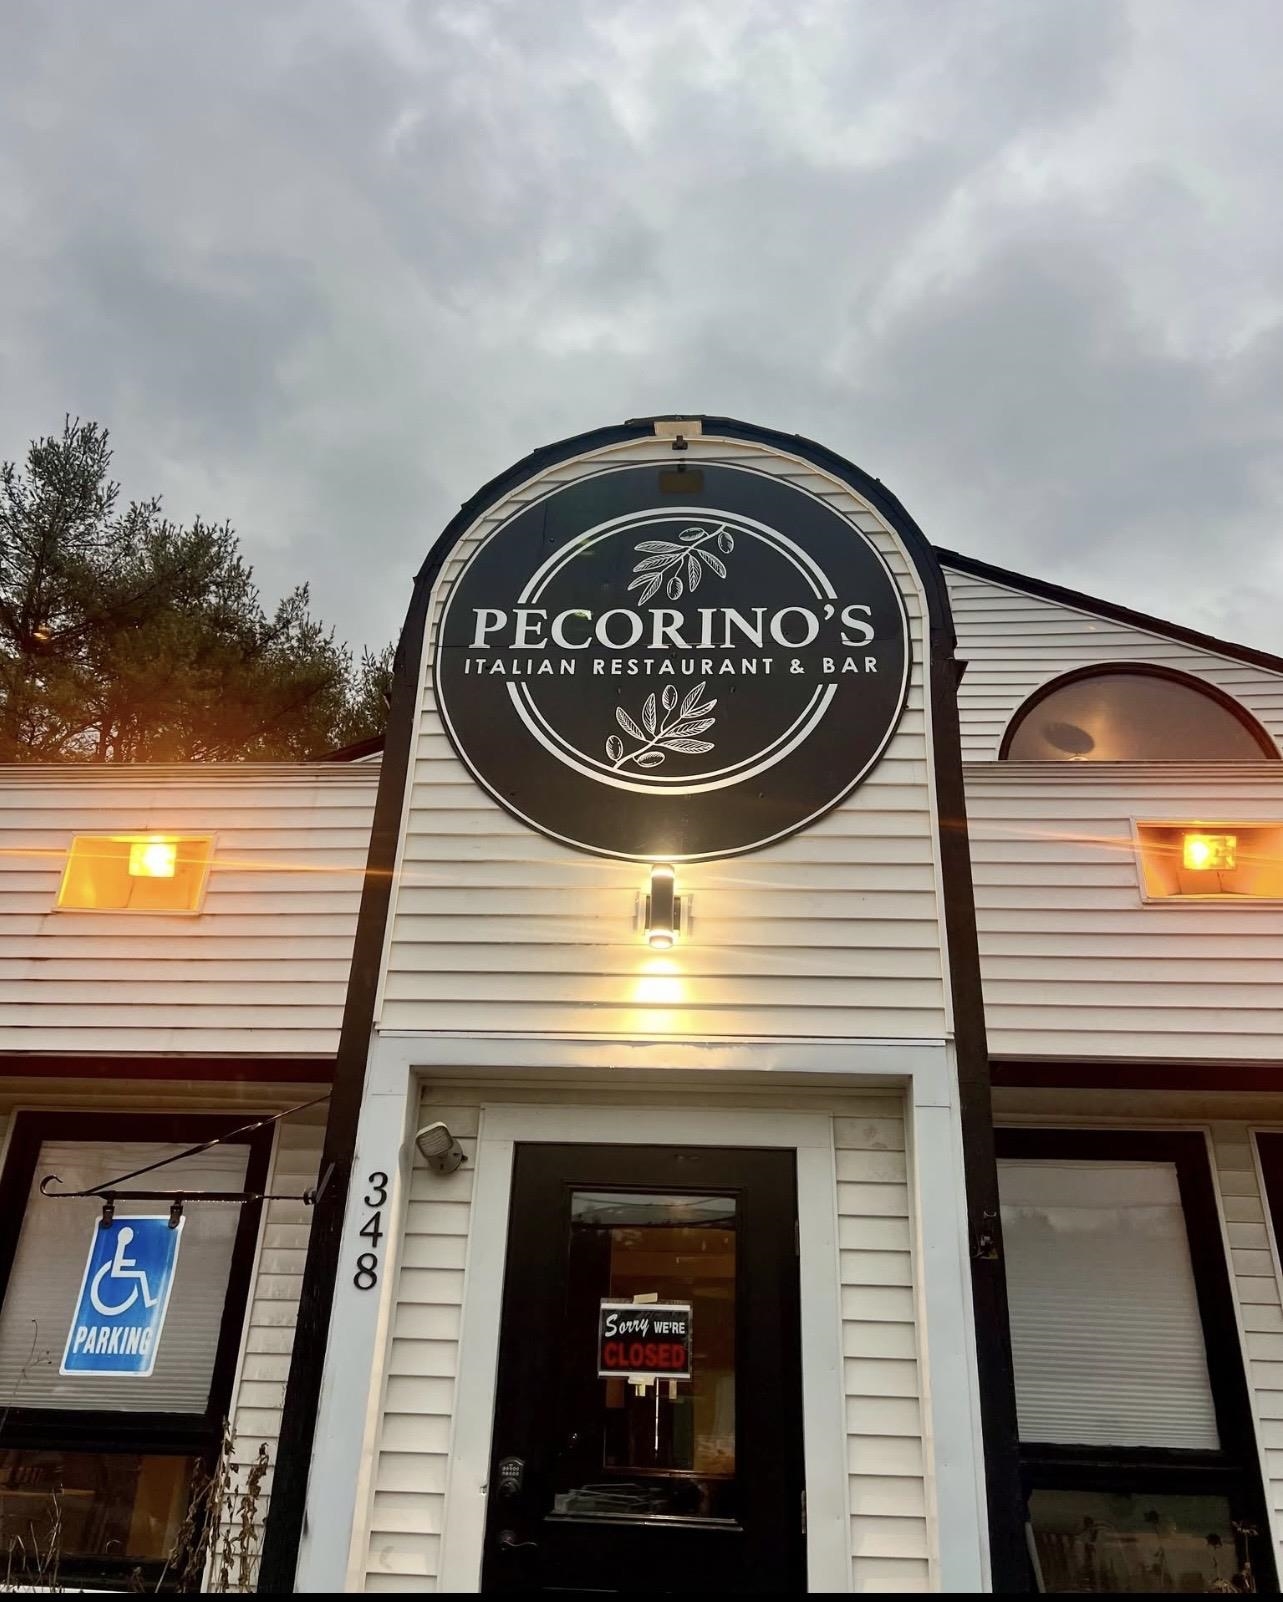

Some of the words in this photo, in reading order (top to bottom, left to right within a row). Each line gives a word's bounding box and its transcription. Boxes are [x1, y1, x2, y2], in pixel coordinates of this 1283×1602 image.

[468, 604, 875, 650] PECORINO'S
[464, 658, 577, 675] ITALIAN
[593, 657, 774, 675] RESTAURANT
[789, 659, 806, 674] &
[822, 656, 879, 673] BAR
[353, 1171, 389, 1291] 348
[605, 1313, 650, 1337] Sorry
[653, 1321, 686, 1335] WE'RE
[72, 1326, 154, 1356] PARKING
[604, 1342, 686, 1368] CLOSED
